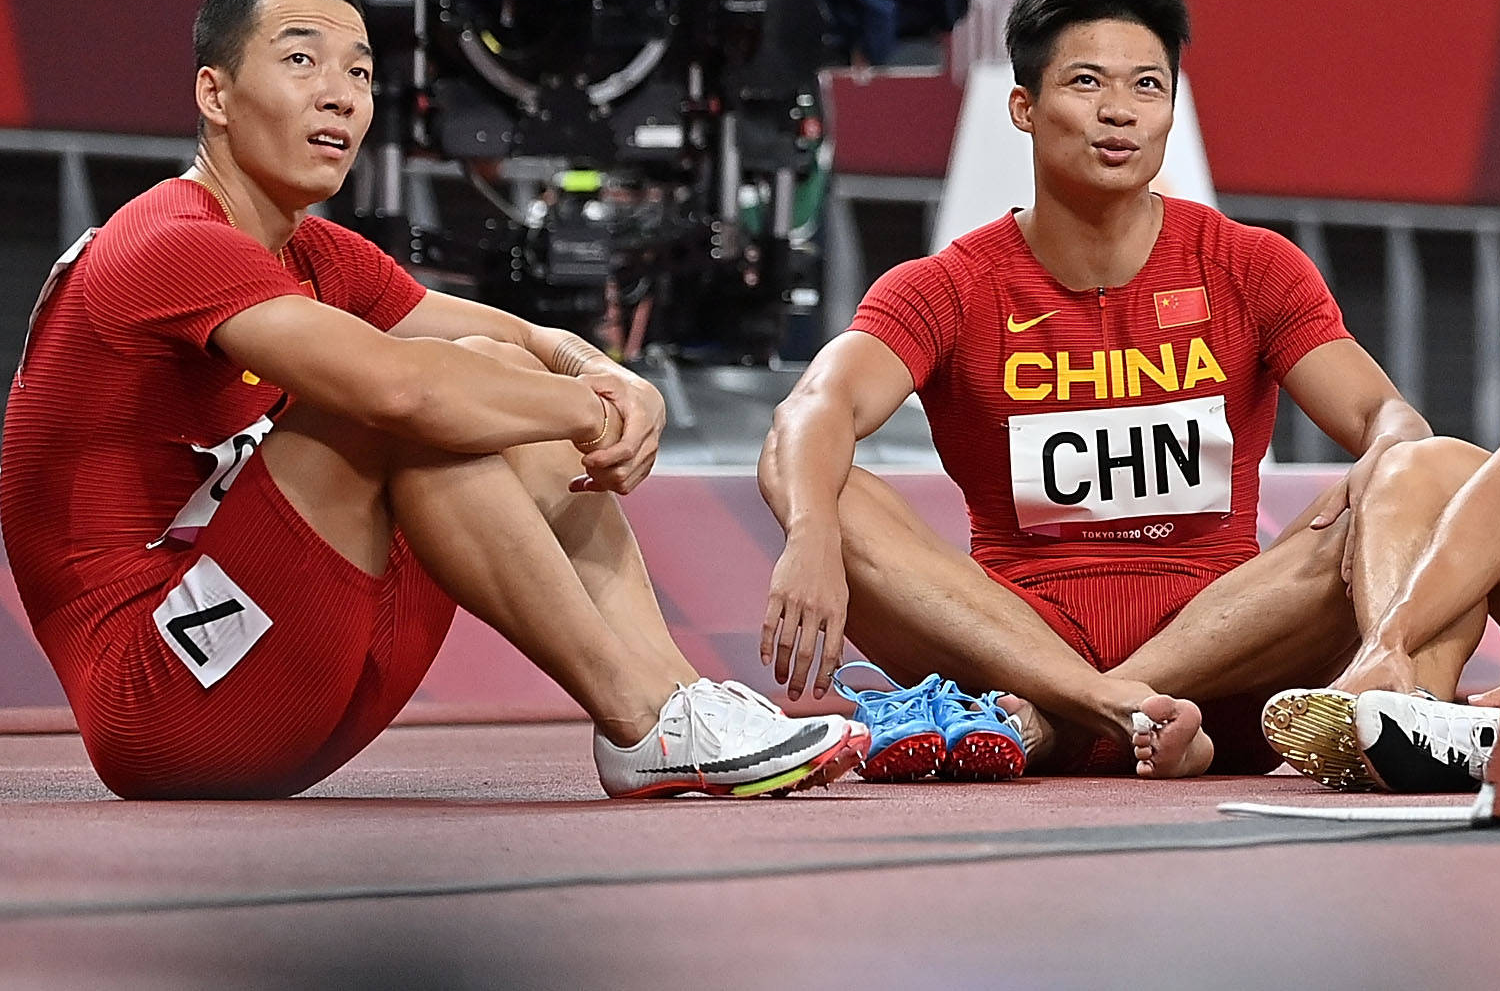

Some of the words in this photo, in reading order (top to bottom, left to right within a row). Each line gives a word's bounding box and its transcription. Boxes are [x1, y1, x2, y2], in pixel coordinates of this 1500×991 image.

[1003, 337, 1228, 401] CHINA
[1041, 419, 1201, 506] CHN
[1081, 530, 1115, 539] TOKYO
[1117, 529, 1141, 539] 2020
